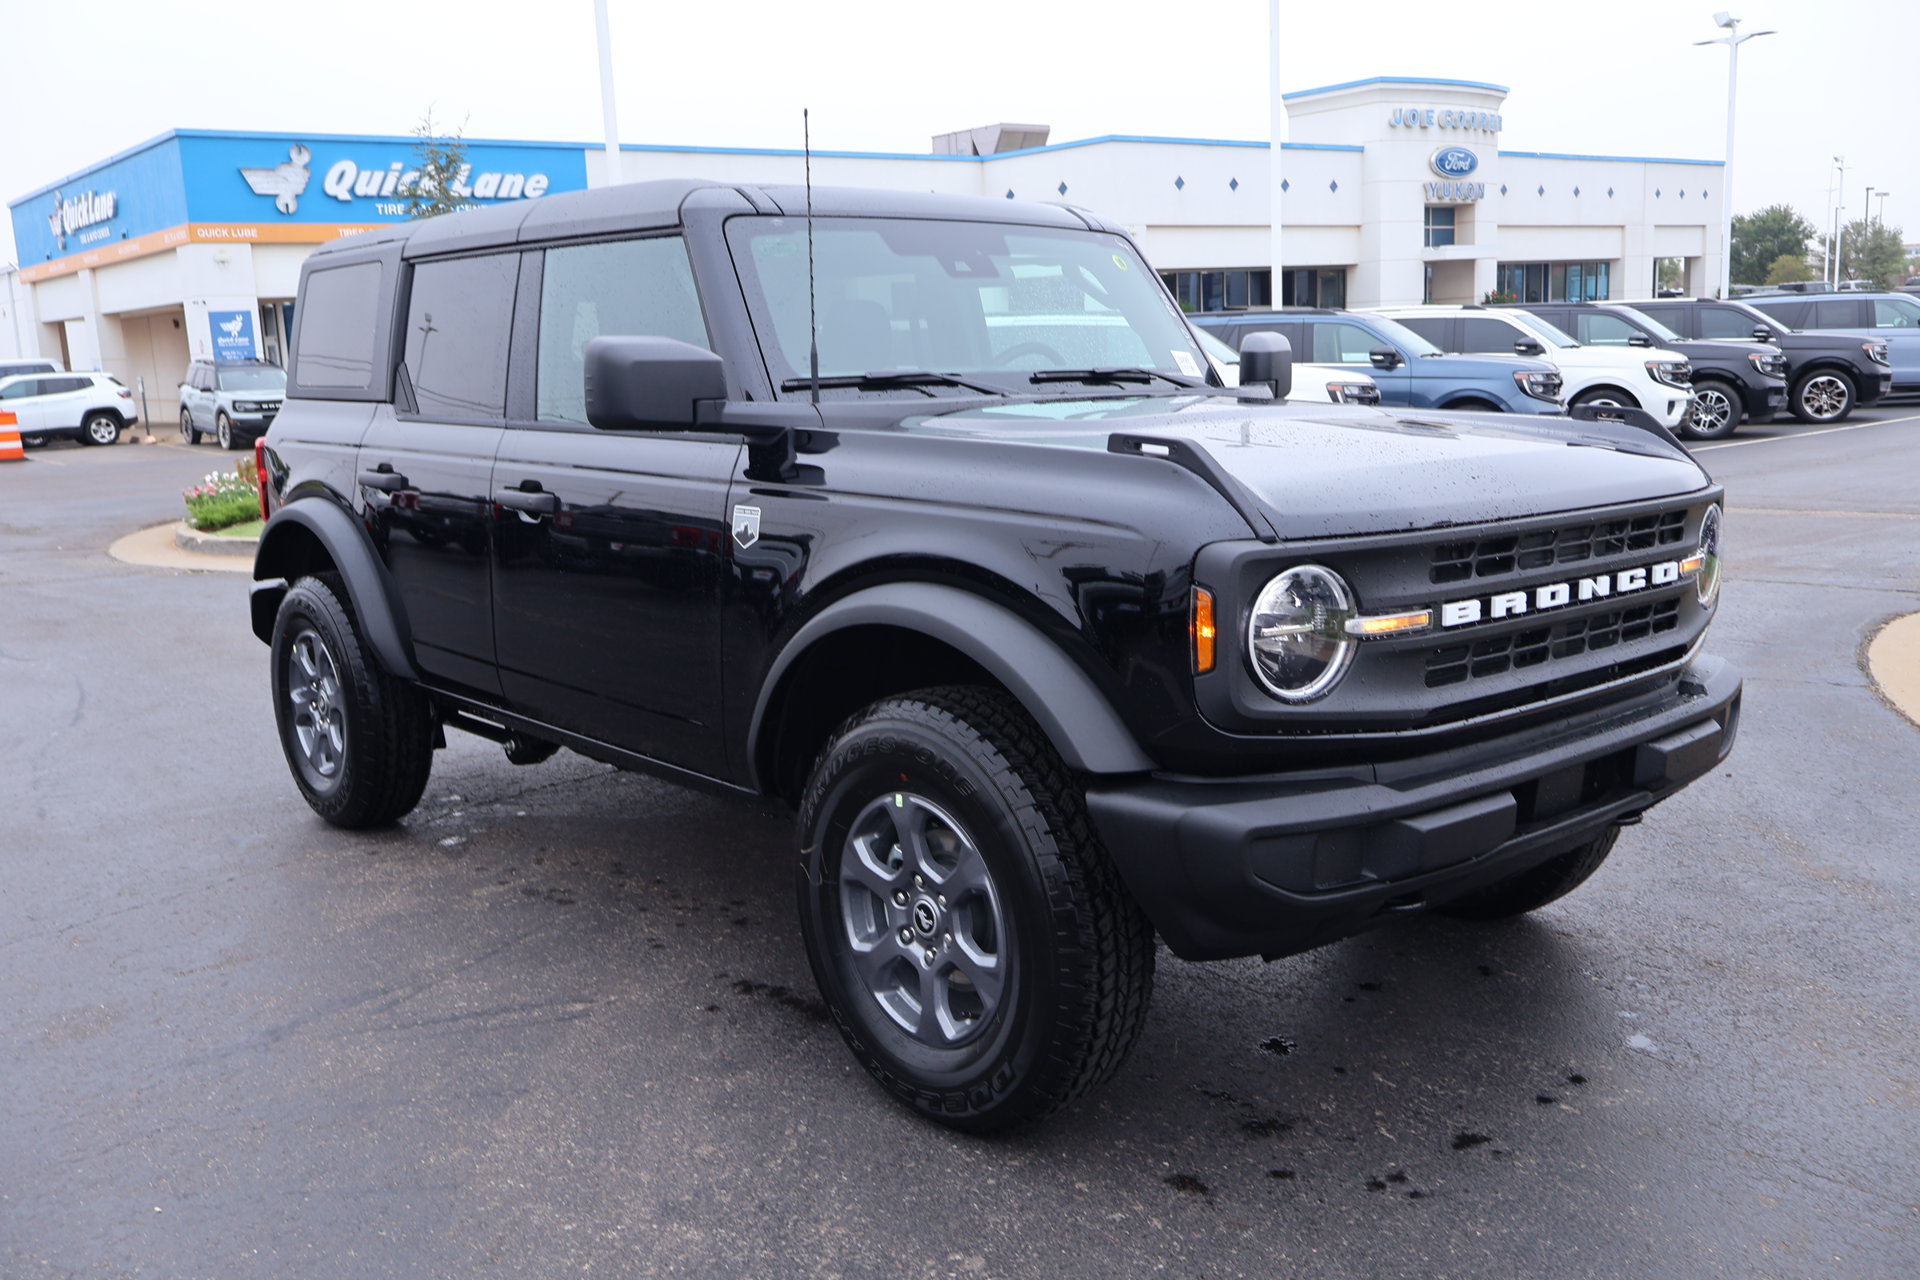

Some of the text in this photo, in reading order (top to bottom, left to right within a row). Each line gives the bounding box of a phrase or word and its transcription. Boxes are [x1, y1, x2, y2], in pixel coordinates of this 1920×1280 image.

[1391, 108, 1434, 128] JOE
[1444, 151, 1471, 170] Ford
[450, 163, 549, 199] Lane
[1428, 181, 1485, 200] YUKON
[63, 192, 90, 236] Quick
[88, 190, 116, 225] Lane
[375, 203, 405, 215] TIRE
[197, 227, 230, 239] QUICK
[231, 227, 258, 239] LUBE
[1441, 560, 1679, 627] BRONCO
